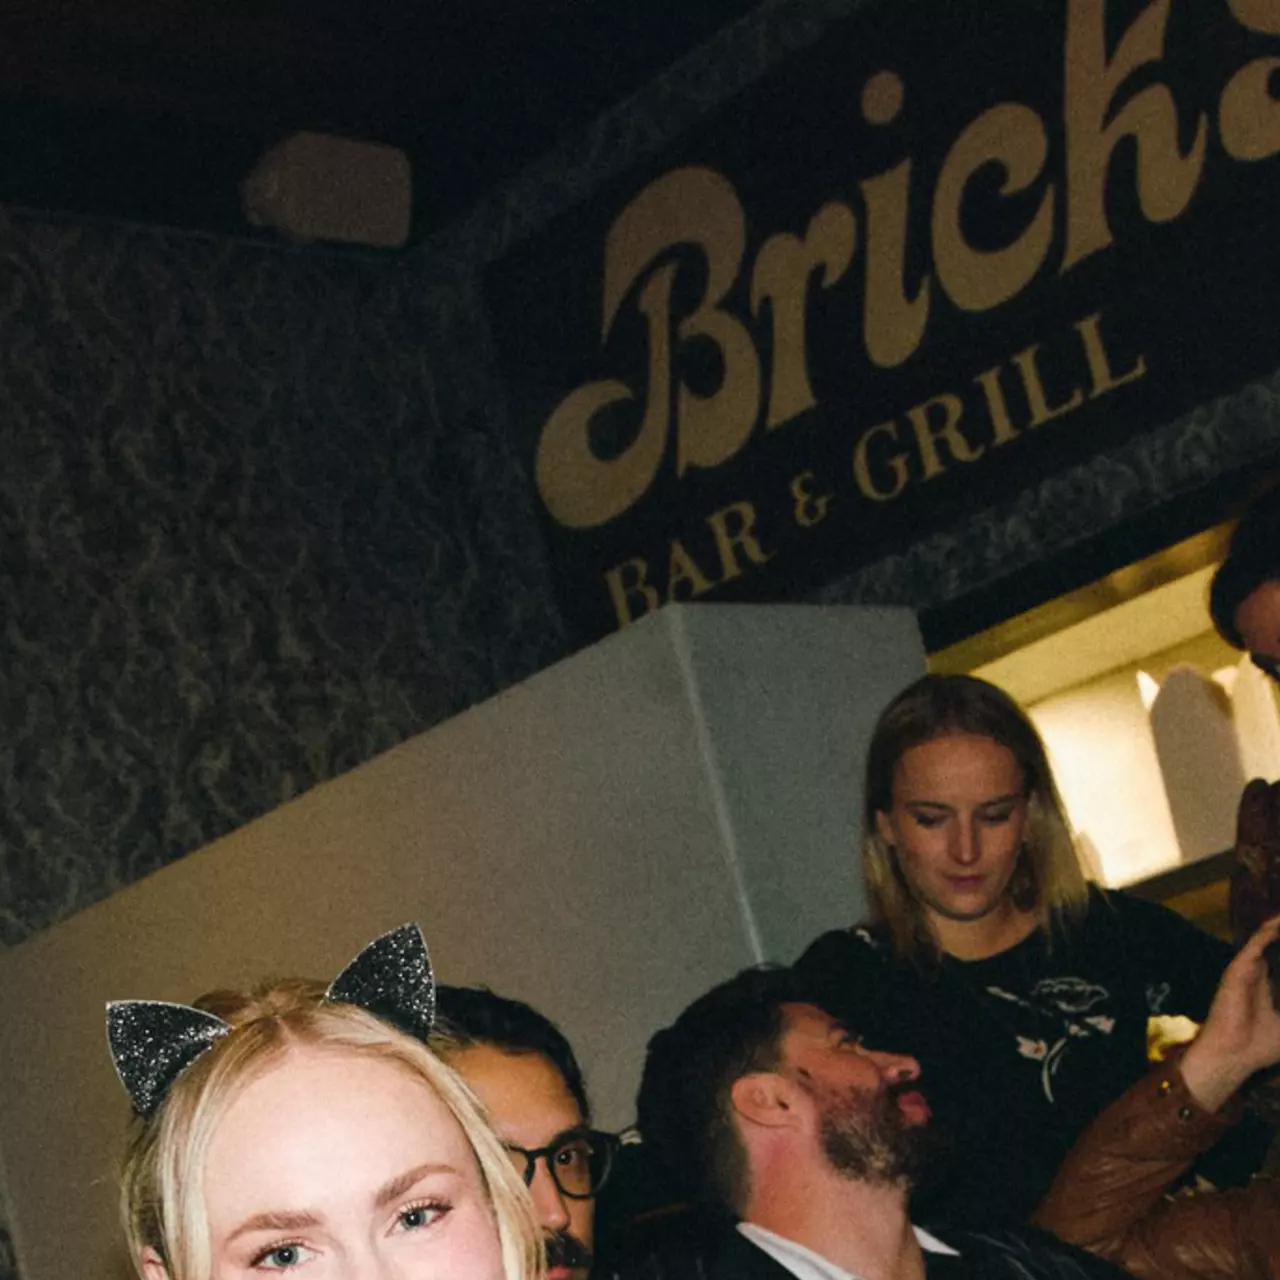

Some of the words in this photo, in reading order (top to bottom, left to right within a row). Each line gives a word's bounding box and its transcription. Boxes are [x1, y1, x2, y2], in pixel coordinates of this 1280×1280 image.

[604, 501, 777, 630] BAR
[791, 470, 834, 527] &
[852, 314, 1147, 502] GRILL
